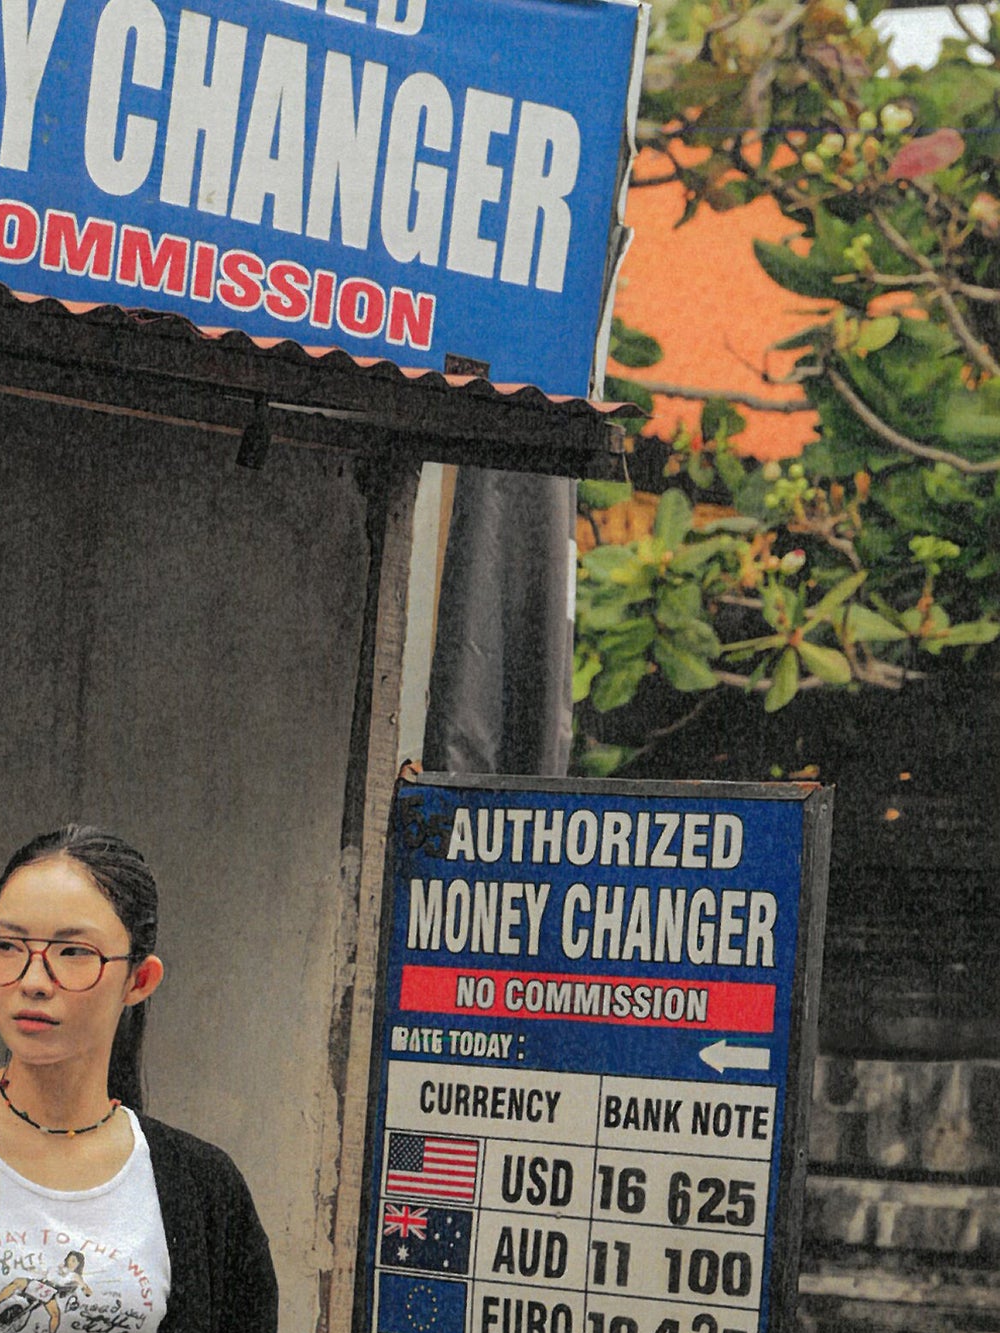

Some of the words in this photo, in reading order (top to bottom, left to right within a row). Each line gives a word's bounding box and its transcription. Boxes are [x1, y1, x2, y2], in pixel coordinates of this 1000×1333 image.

[85, 0, 582, 293] CHANGER
[446, 807, 744, 870] AUTHORIZED
[406, 878, 551, 957] MONEY
[561, 882, 778, 968] CHANGER
[455, 976, 496, 1010] NO
[505, 979, 708, 1022] COMMISSION
[449, 1030, 513, 1059] TODAY
[419, 1080, 561, 1123] CURRENCY
[604, 1094, 684, 1133] BANK
[691, 1102, 770, 1140] NOTE
[501, 1154, 573, 1207] USD
[491, 1225, 568, 1279] AUD
